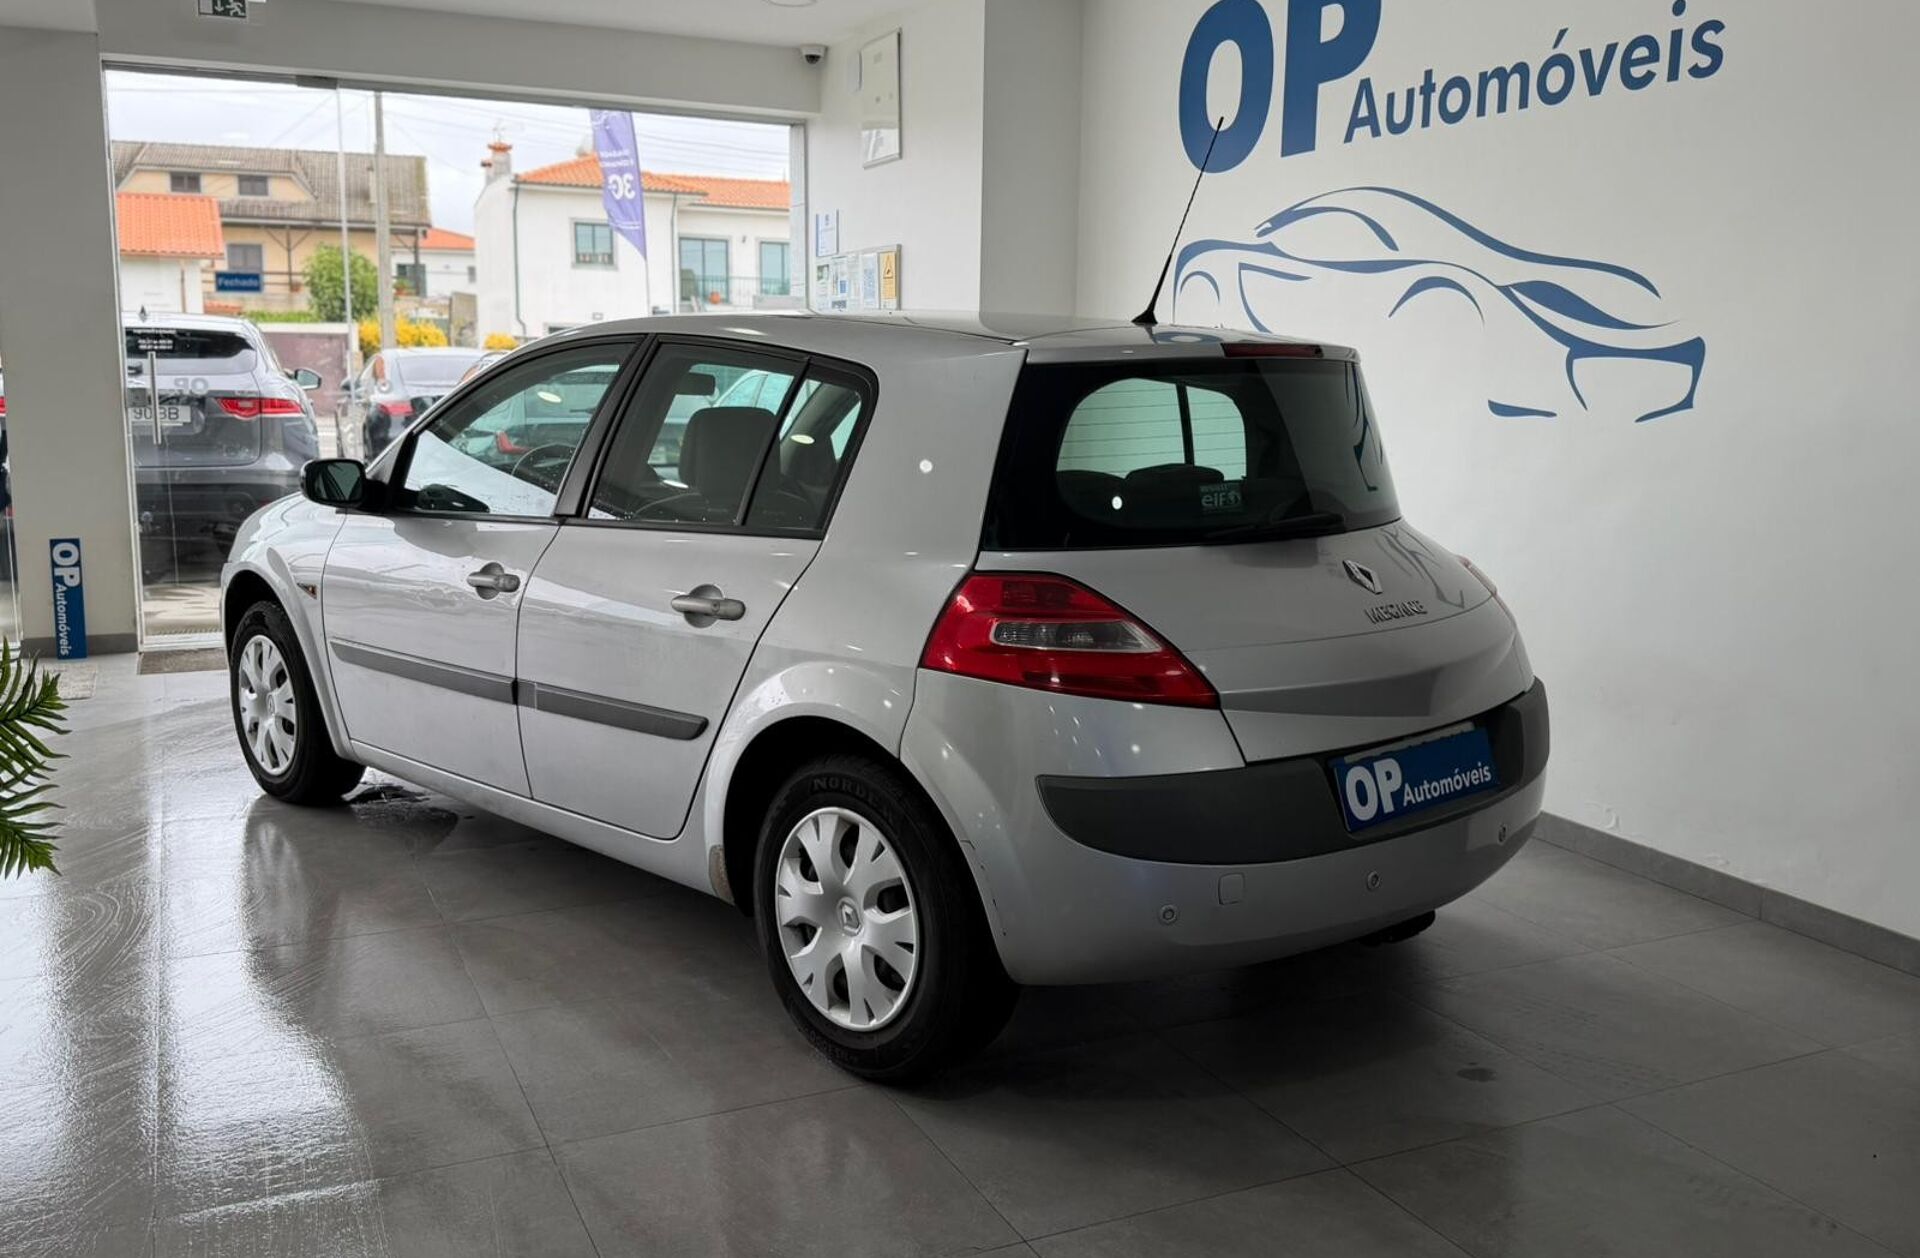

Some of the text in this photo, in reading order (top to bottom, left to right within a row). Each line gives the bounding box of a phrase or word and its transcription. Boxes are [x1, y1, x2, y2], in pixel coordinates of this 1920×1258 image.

[1179, 0, 1726, 173] OP Automóveis
[52, 542, 81, 656] OP Automóveis
[1345, 757, 1492, 821] OP Automóveis
